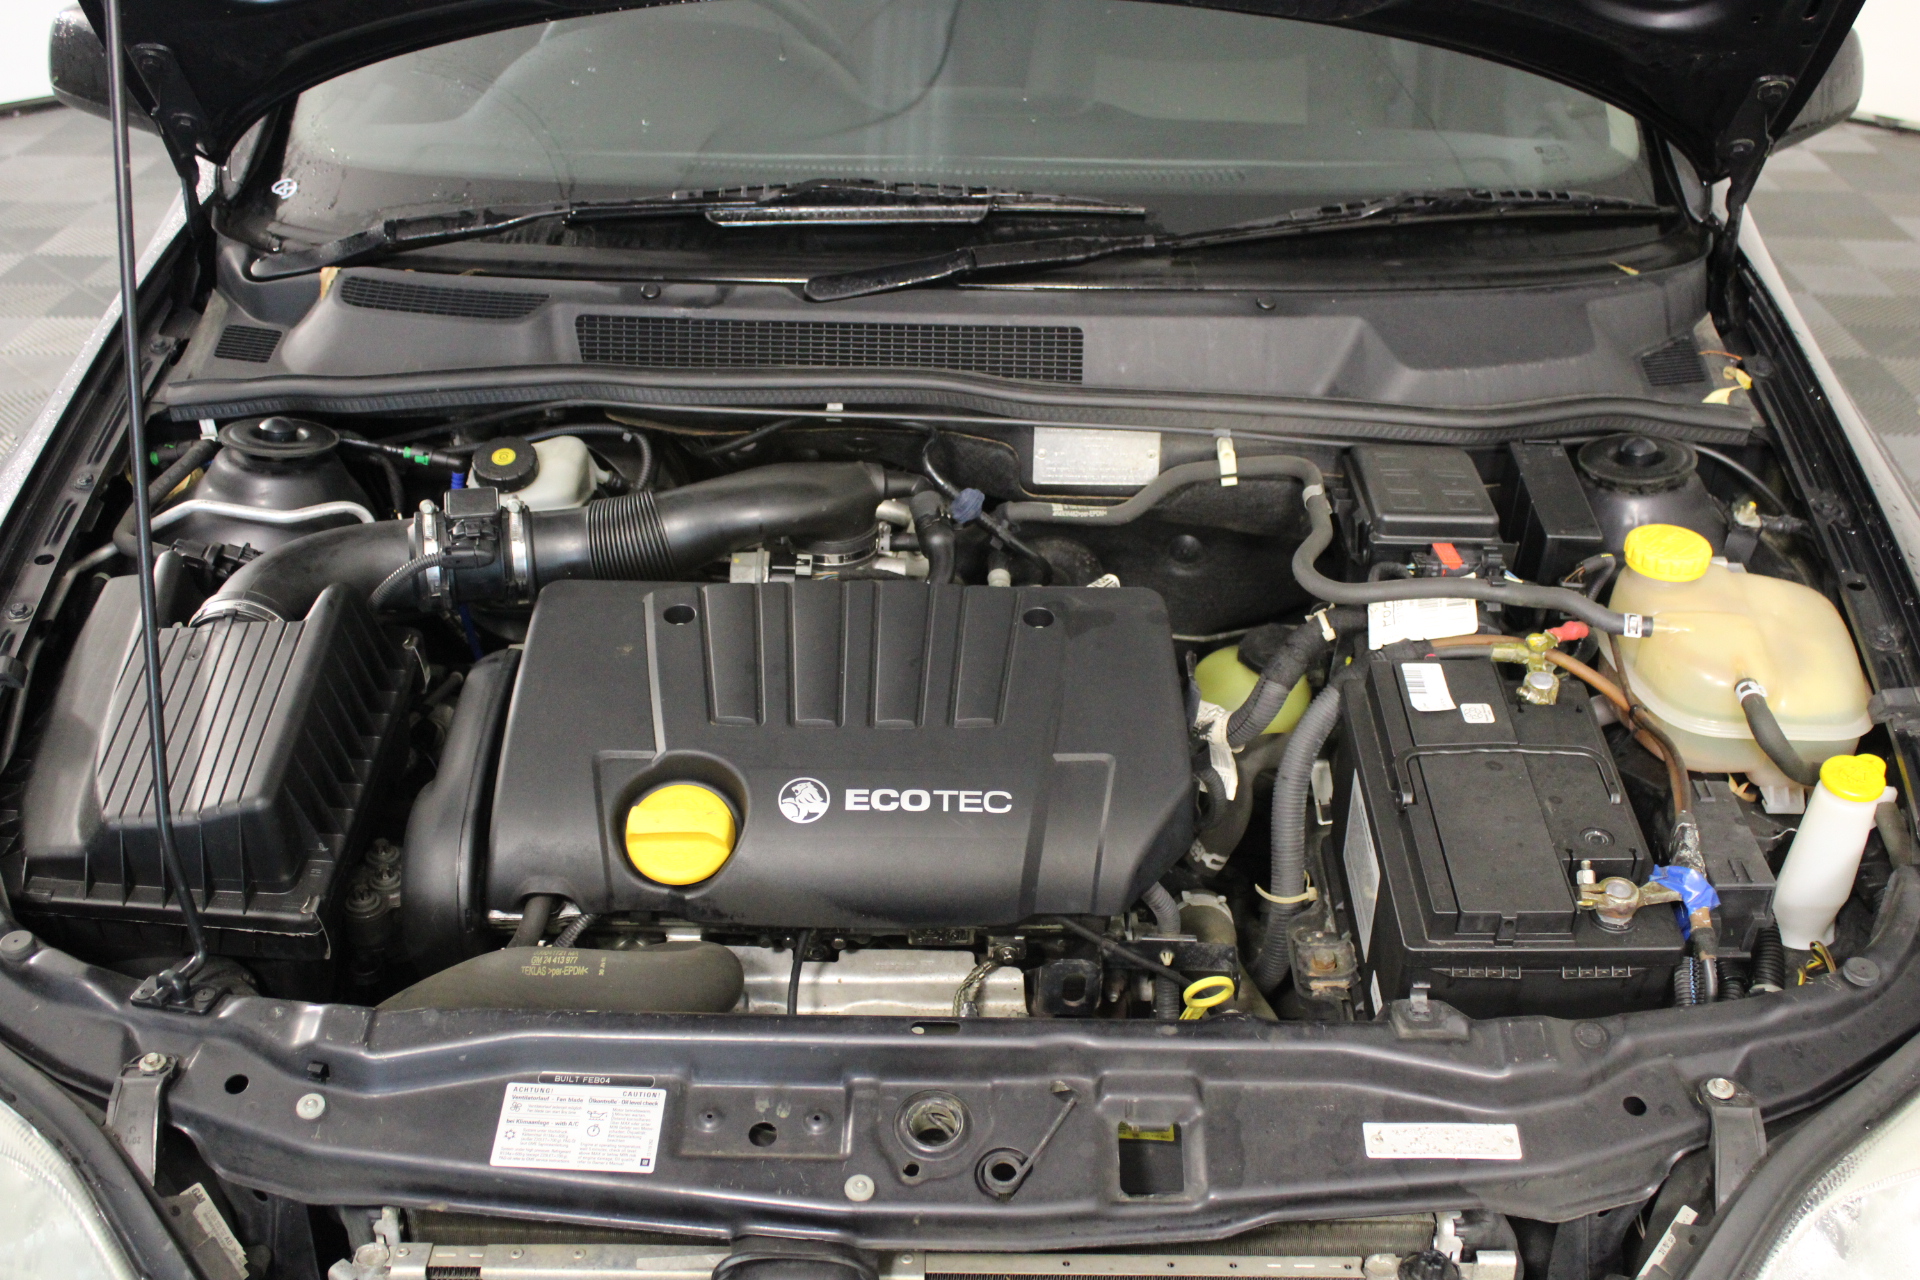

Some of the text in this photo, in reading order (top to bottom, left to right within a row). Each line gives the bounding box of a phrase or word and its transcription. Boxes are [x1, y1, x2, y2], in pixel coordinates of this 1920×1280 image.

[844, 788, 1013, 814] ECOTEC
[531, 956, 542, 965] GM
[521, 966, 546, 976] TEKLAS
[554, 1075, 611, 1084] BUILT FEB04
